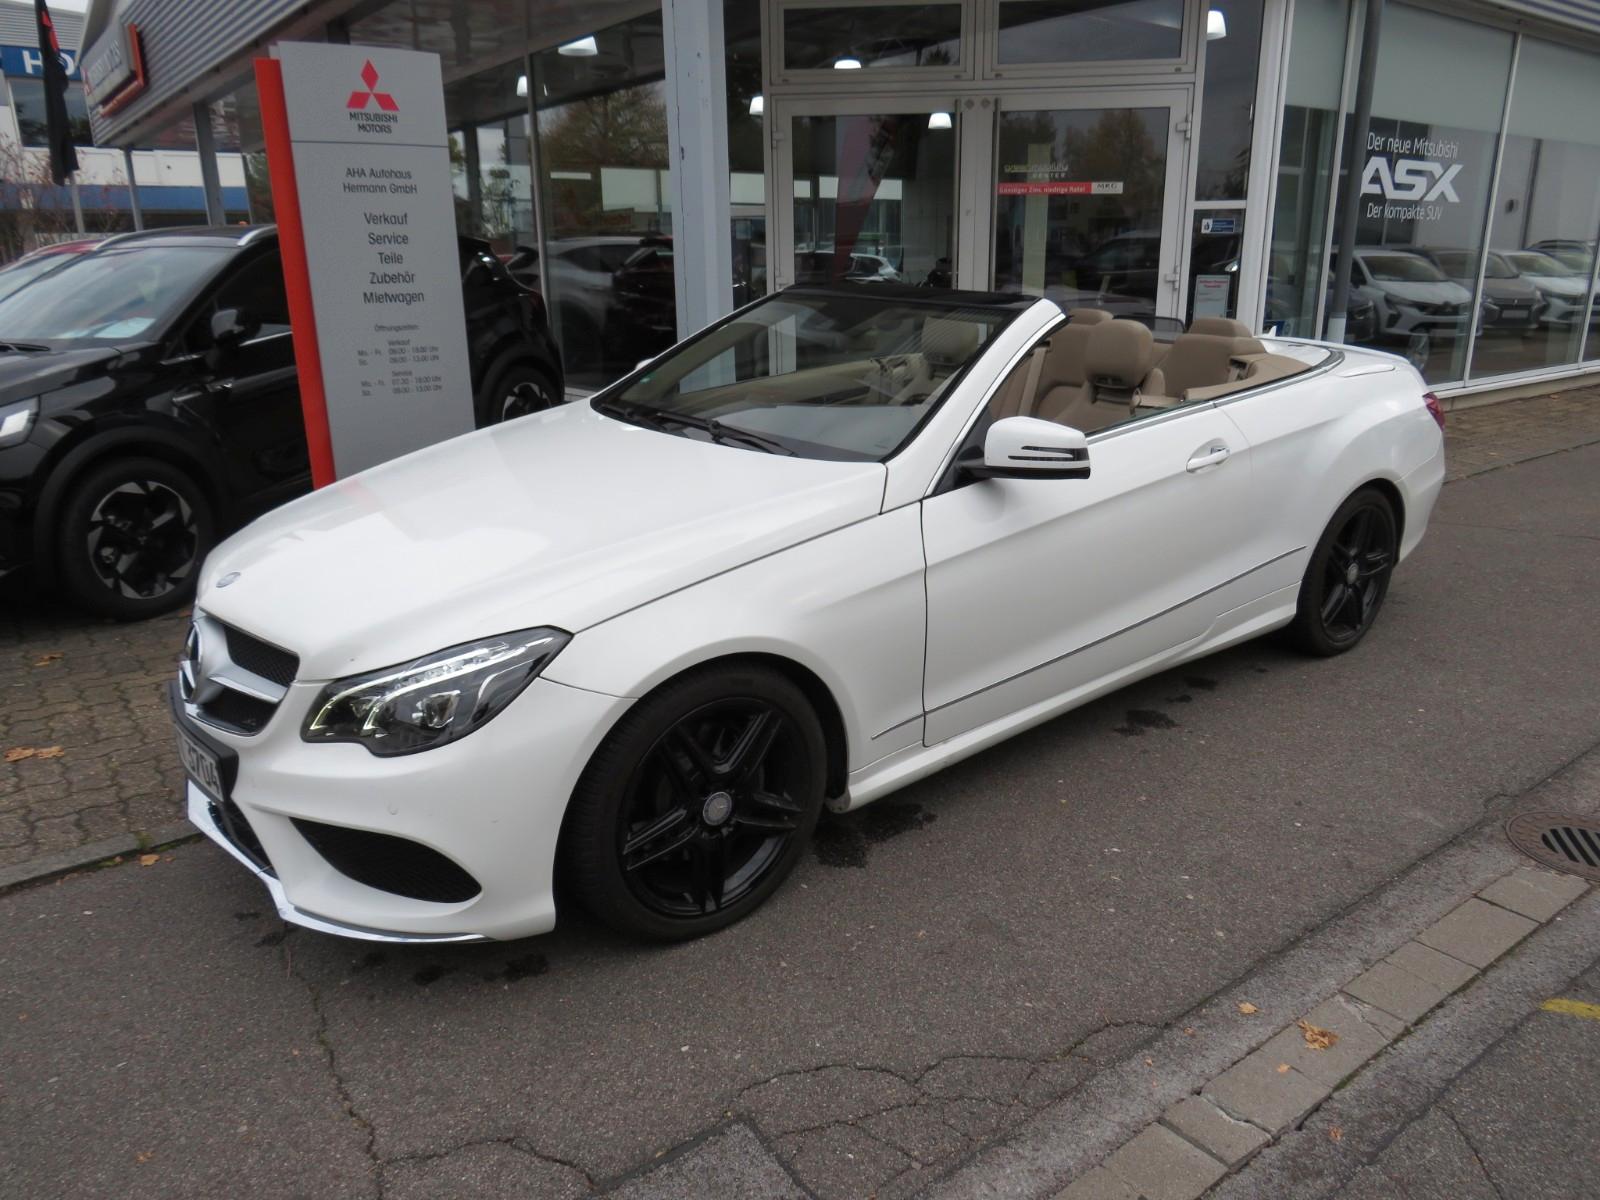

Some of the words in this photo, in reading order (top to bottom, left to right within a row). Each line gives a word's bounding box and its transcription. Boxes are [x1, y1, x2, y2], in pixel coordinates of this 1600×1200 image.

[349, 111, 398, 124] MITSUBISHI
[358, 123, 392, 134] MOTORS
[1367, 131, 1385, 151] Der
[1387, 137, 1411, 154] neue
[1413, 137, 1459, 159] Mitsubishi
[345, 167, 367, 178] AHA
[369, 168, 412, 180] Autohaus
[1360, 155, 1464, 203] ASX
[343, 182, 387, 193] Hermann
[389, 183, 418, 194] GmbH
[363, 212, 408, 225] Verkauf
[1367, 202, 1382, 218] Der
[1384, 202, 1424, 222] kompakte
[368, 232, 409, 245] Service
[378, 252, 404, 264] Teile
[369, 271, 416, 285] Zubehör
[363, 291, 425, 305] Mietwagen
